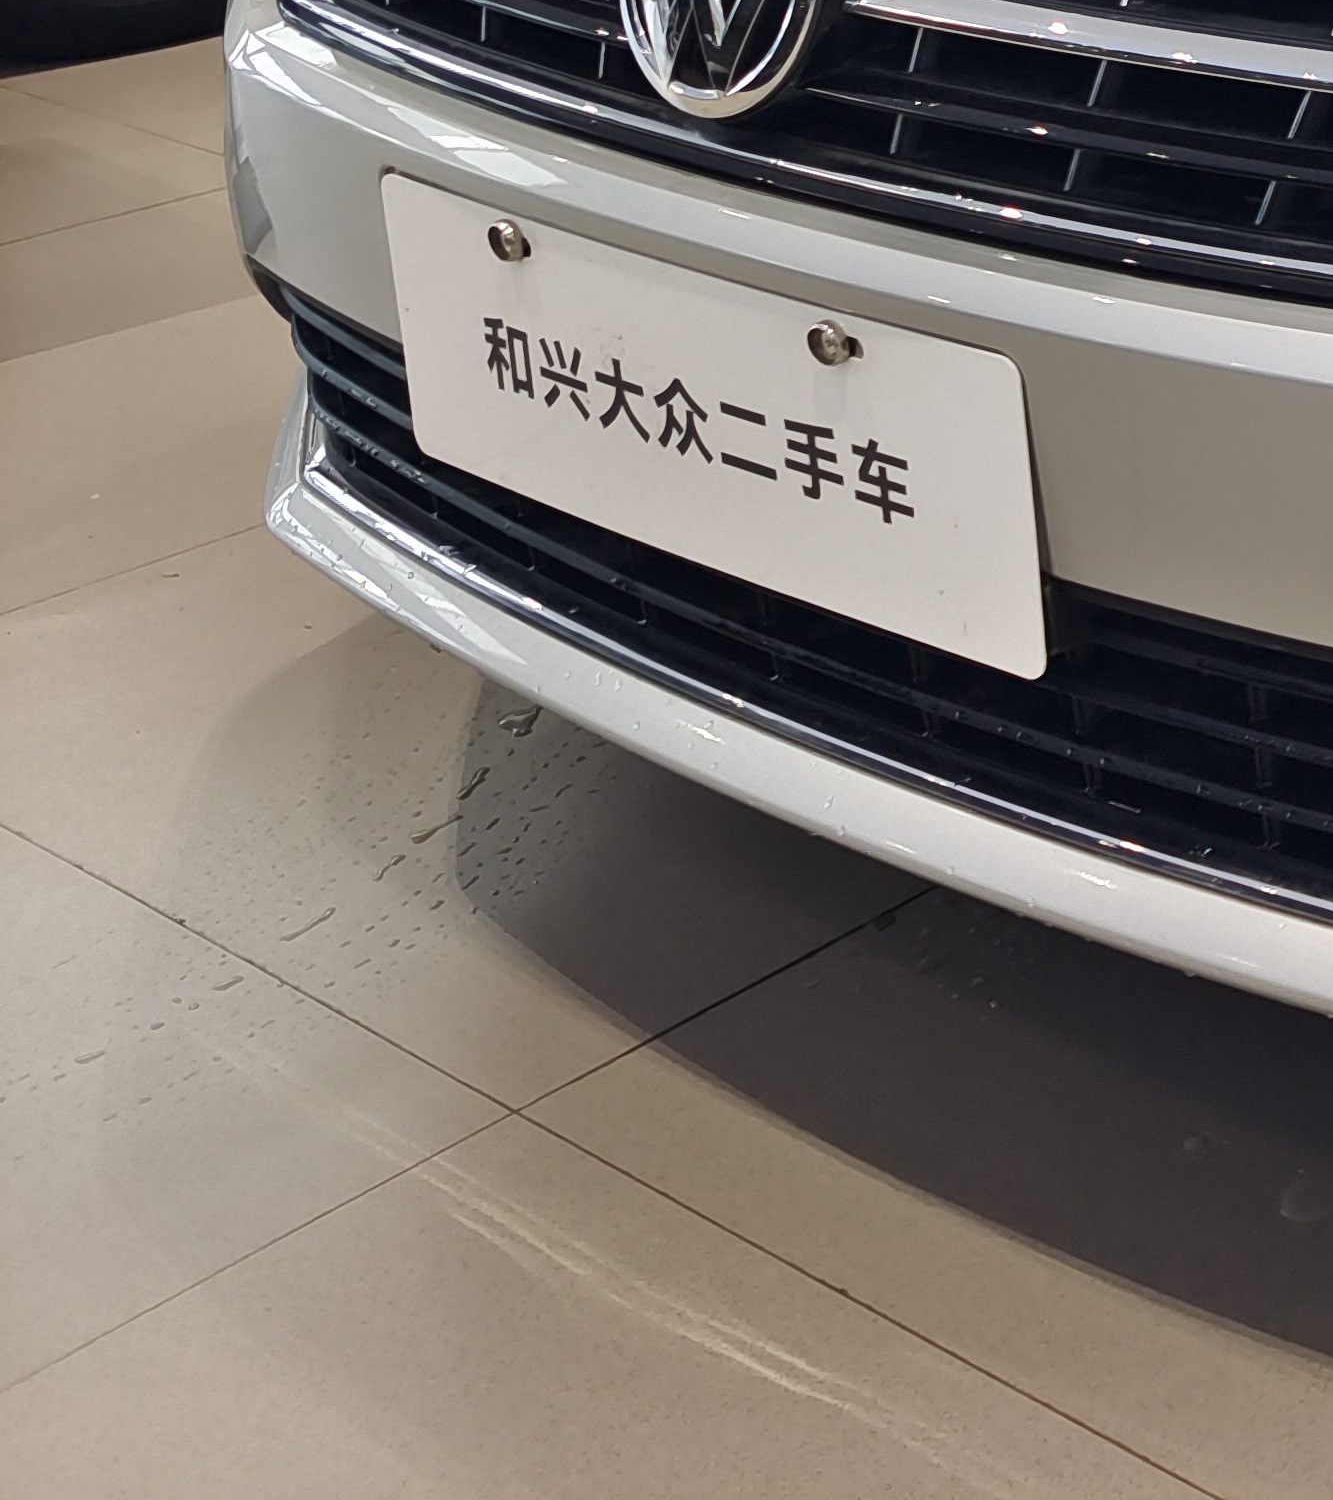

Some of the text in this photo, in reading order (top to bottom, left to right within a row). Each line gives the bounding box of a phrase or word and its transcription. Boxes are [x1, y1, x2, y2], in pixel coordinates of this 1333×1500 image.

[483, 316, 915, 524] 和兴大众二手车
